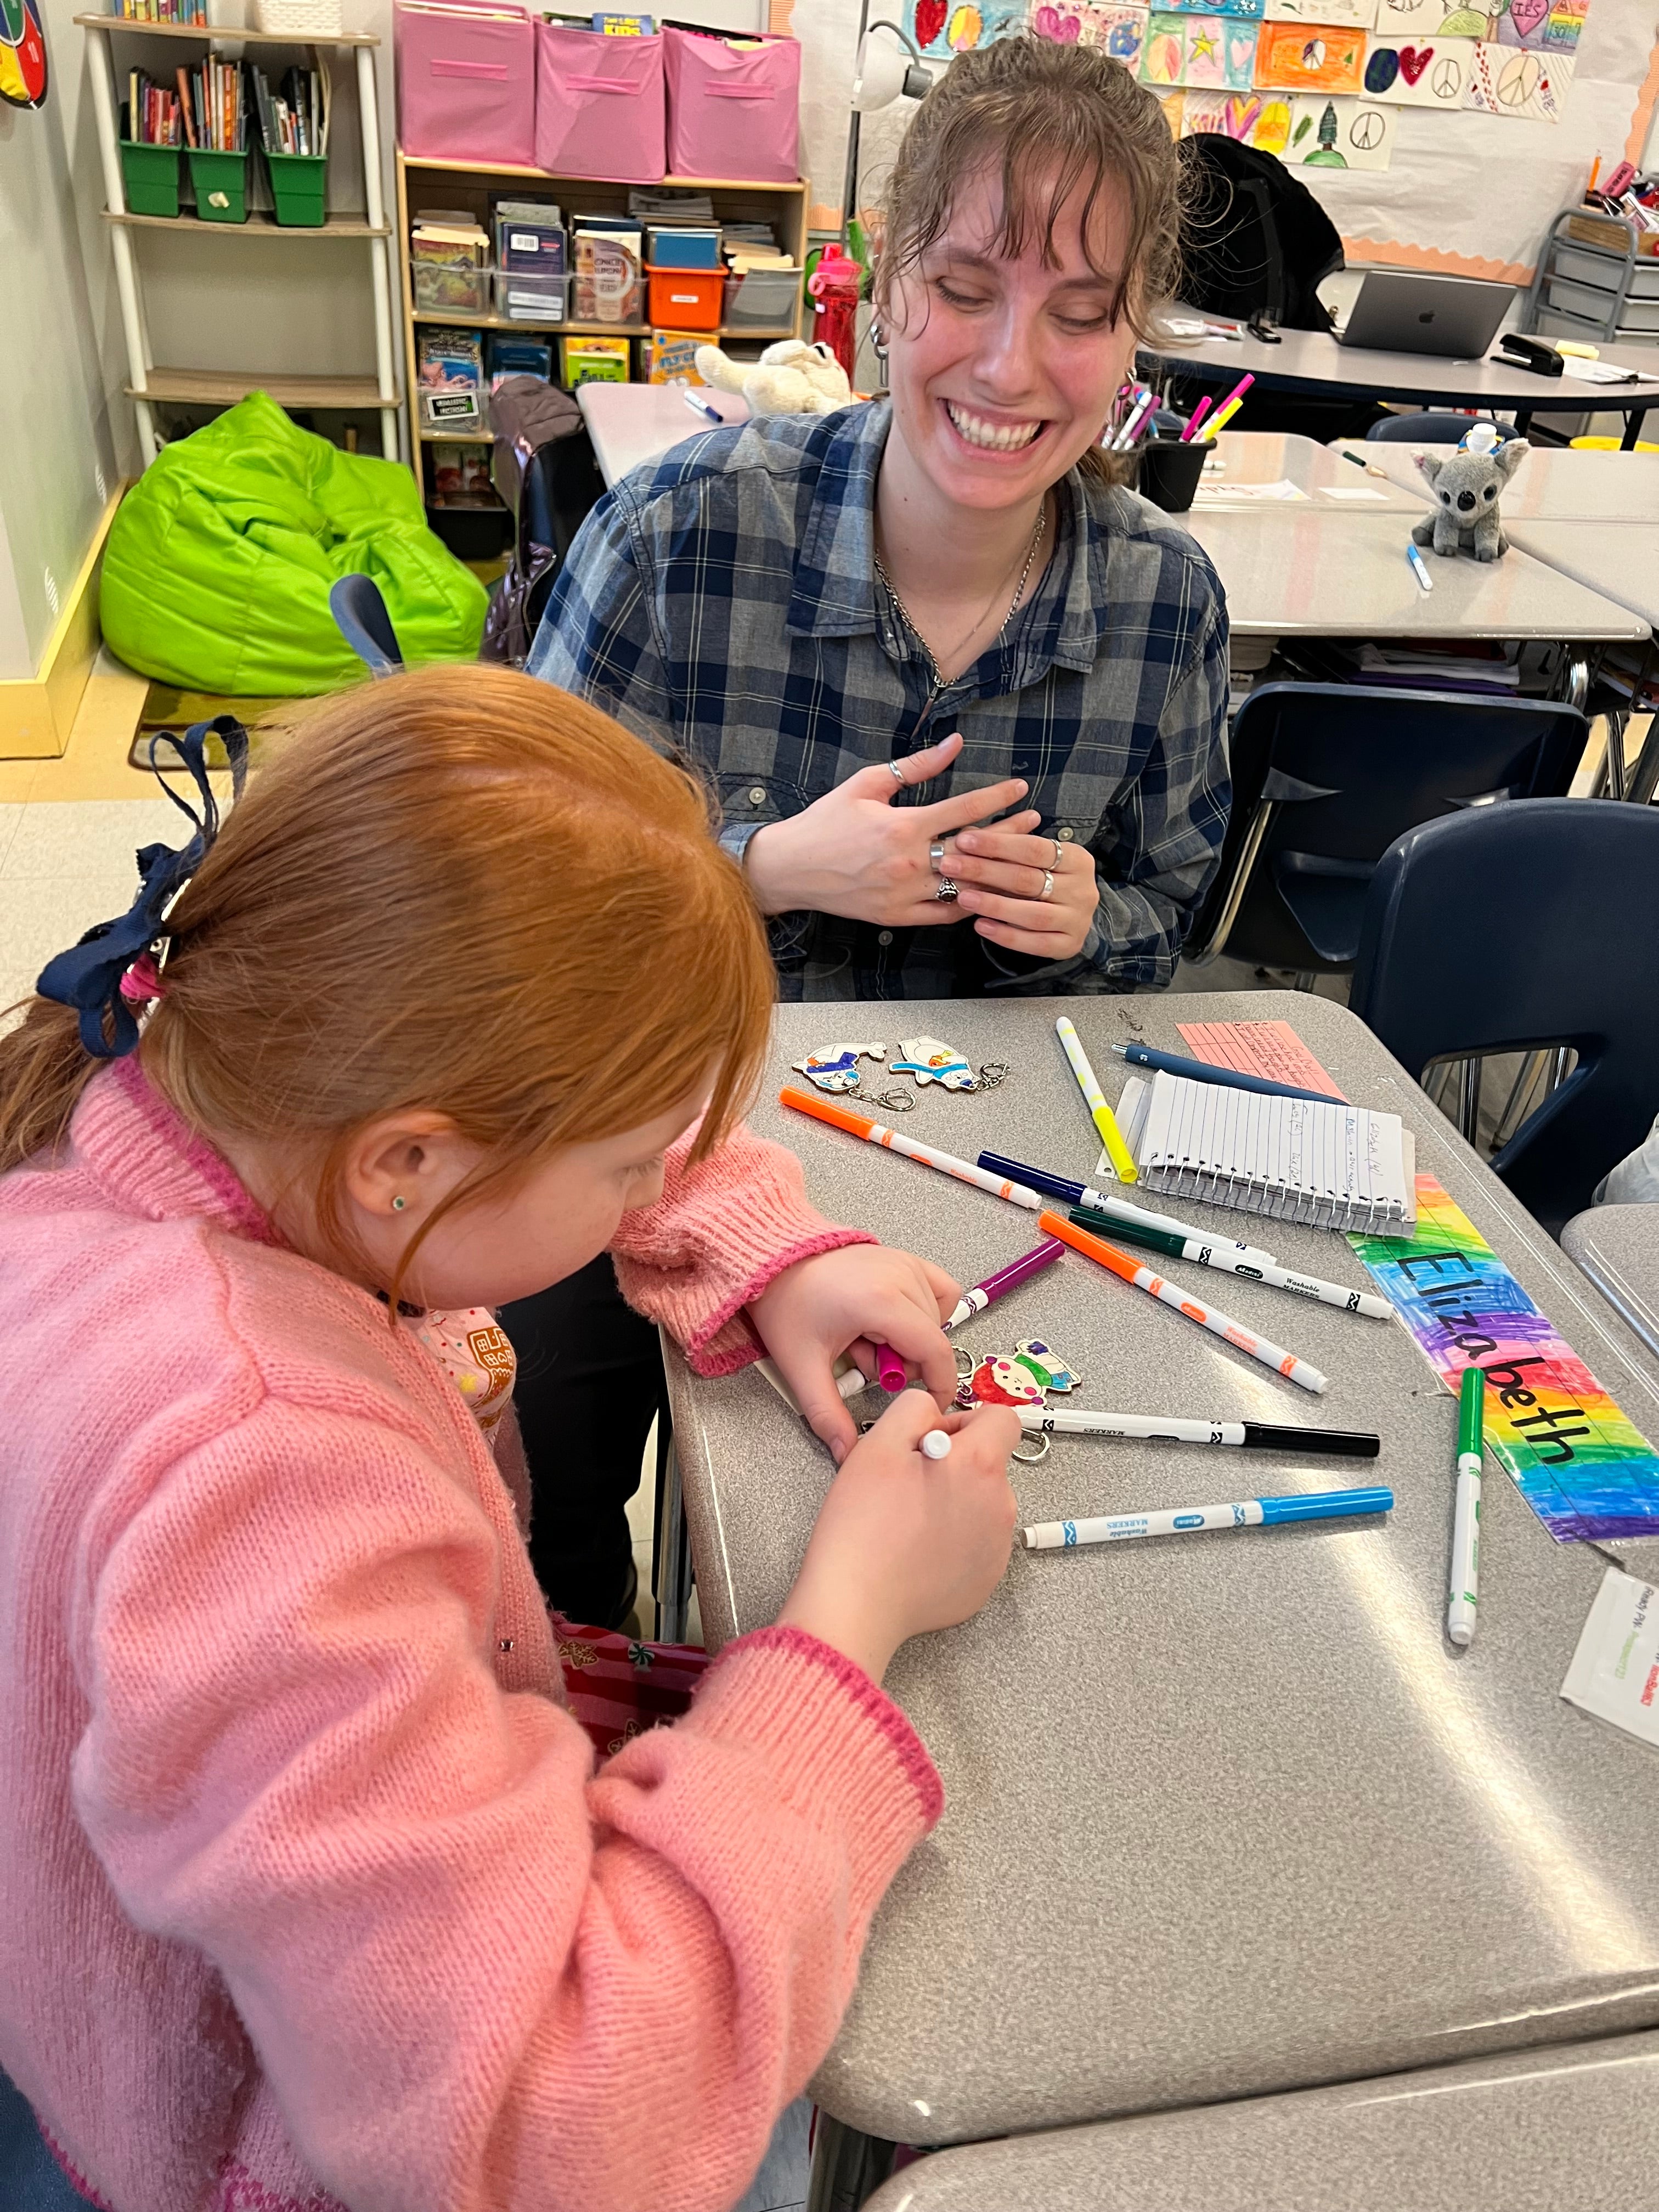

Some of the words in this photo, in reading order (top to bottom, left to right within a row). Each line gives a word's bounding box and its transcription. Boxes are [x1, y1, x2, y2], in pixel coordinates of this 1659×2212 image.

[603, 25, 641, 36] KIDS
[950, 1168, 978, 1184] Washable
[1283, 1284, 1321, 1299] MARKERS
[1286, 1277, 1321, 1293] Washable
[1223, 1332, 1257, 1355] MARKERS
[1226, 1325, 1258, 1347] Washable
[1397, 1251, 1590, 1465] Elizabeth
[1084, 1427, 1126, 1436] MARKERS
[1106, 1518, 1149, 1530] MARKERS
[1109, 1528, 1148, 1538] Washable
